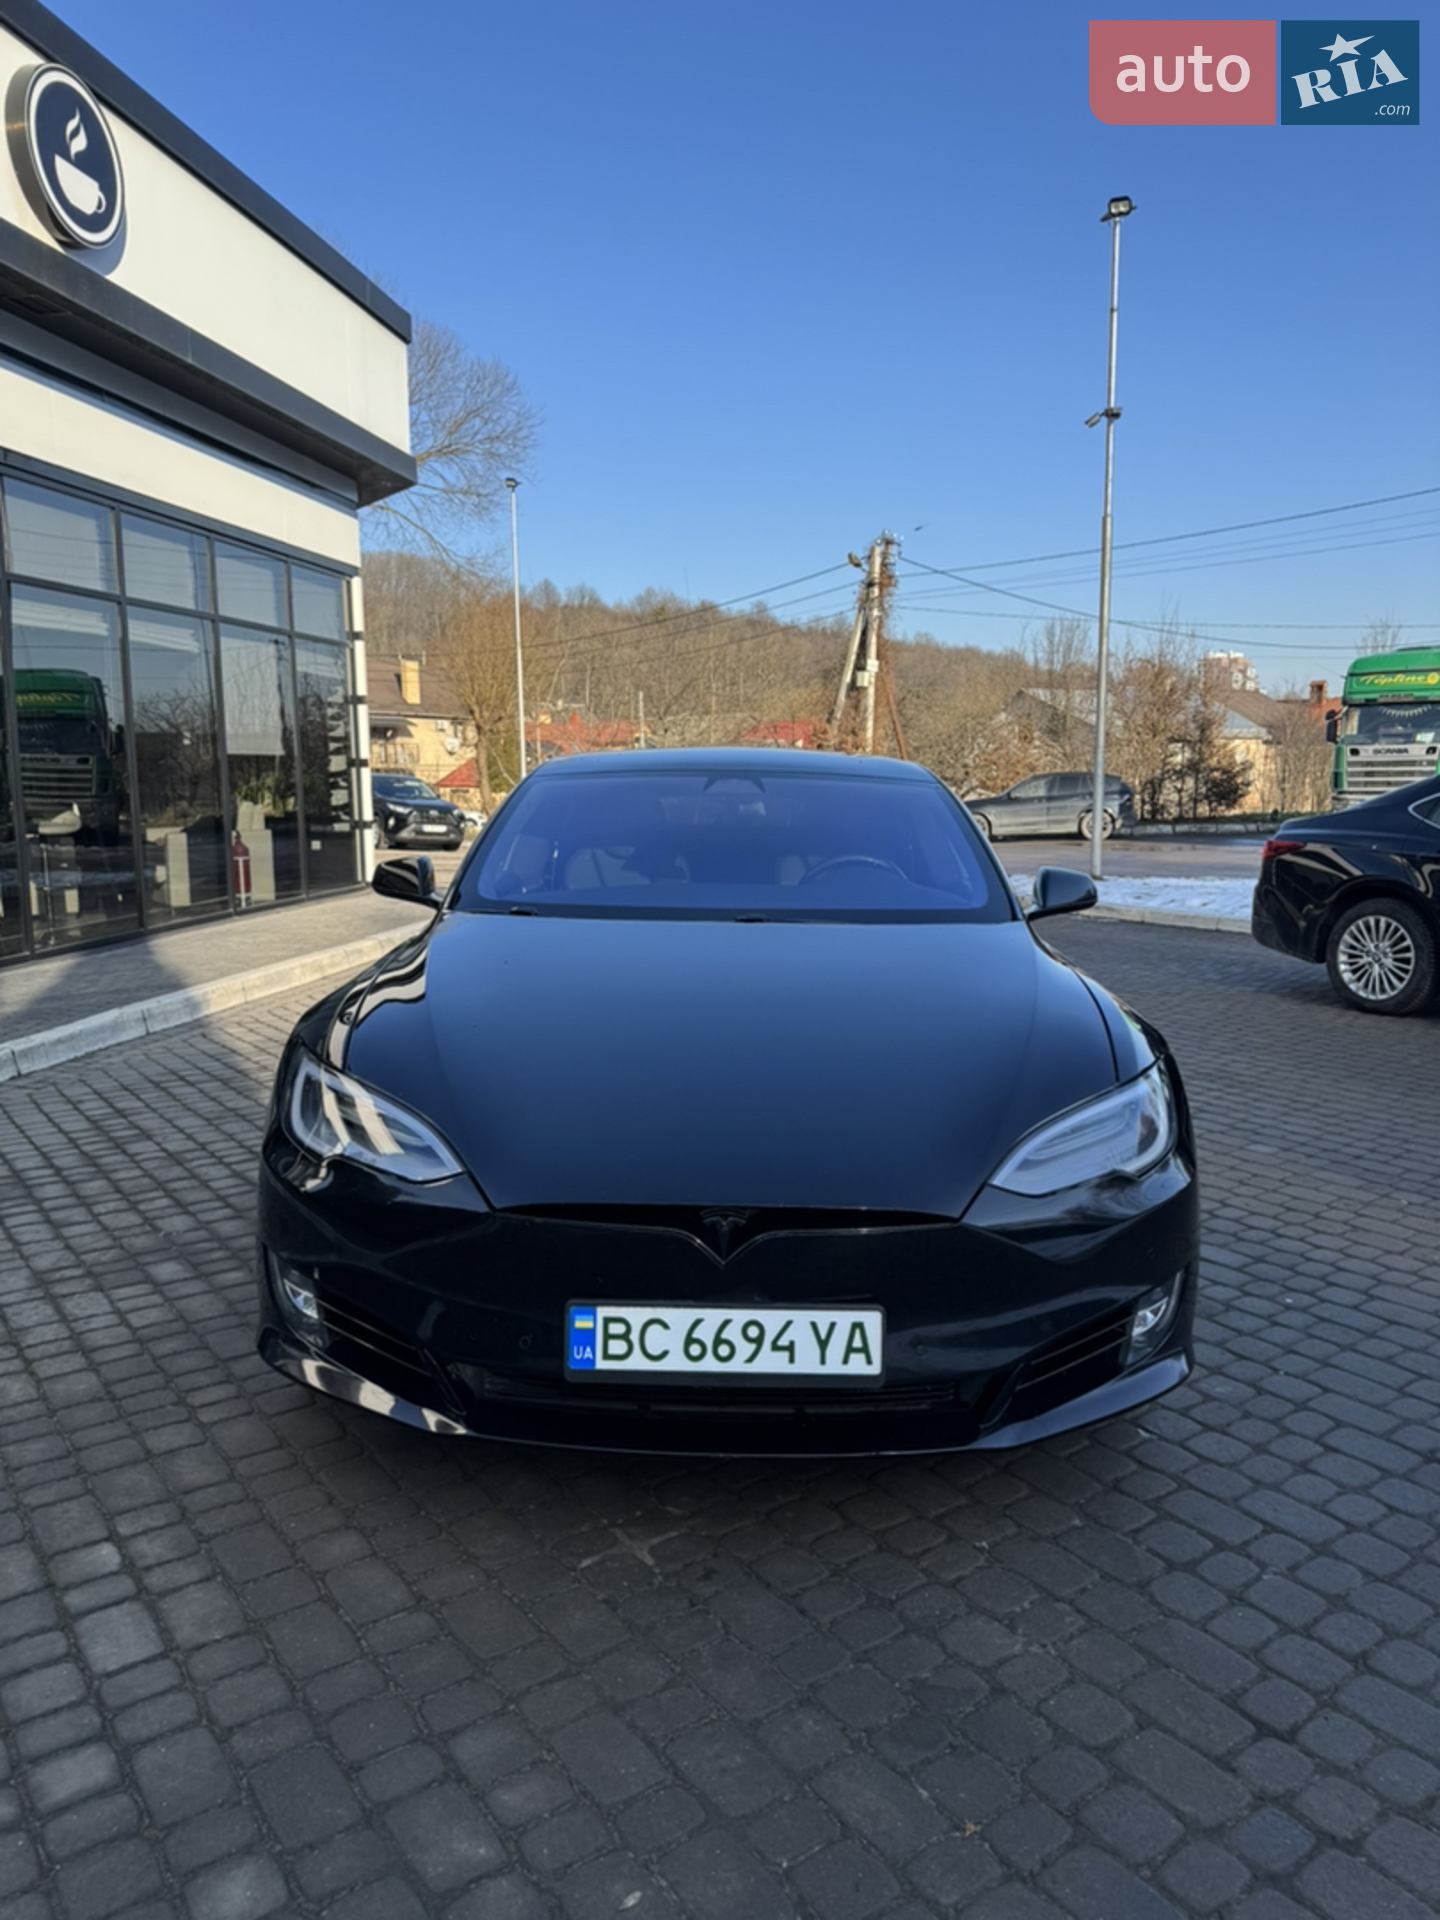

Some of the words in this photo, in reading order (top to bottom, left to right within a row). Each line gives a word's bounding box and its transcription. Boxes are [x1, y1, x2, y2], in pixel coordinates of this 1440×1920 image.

[1372, 747, 1409, 755] SCANIA
[602, 1316, 671, 1362] BC
[682, 1318, 796, 1364] 6694
[809, 1321, 873, 1365] YA
[573, 1346, 594, 1359] UA
